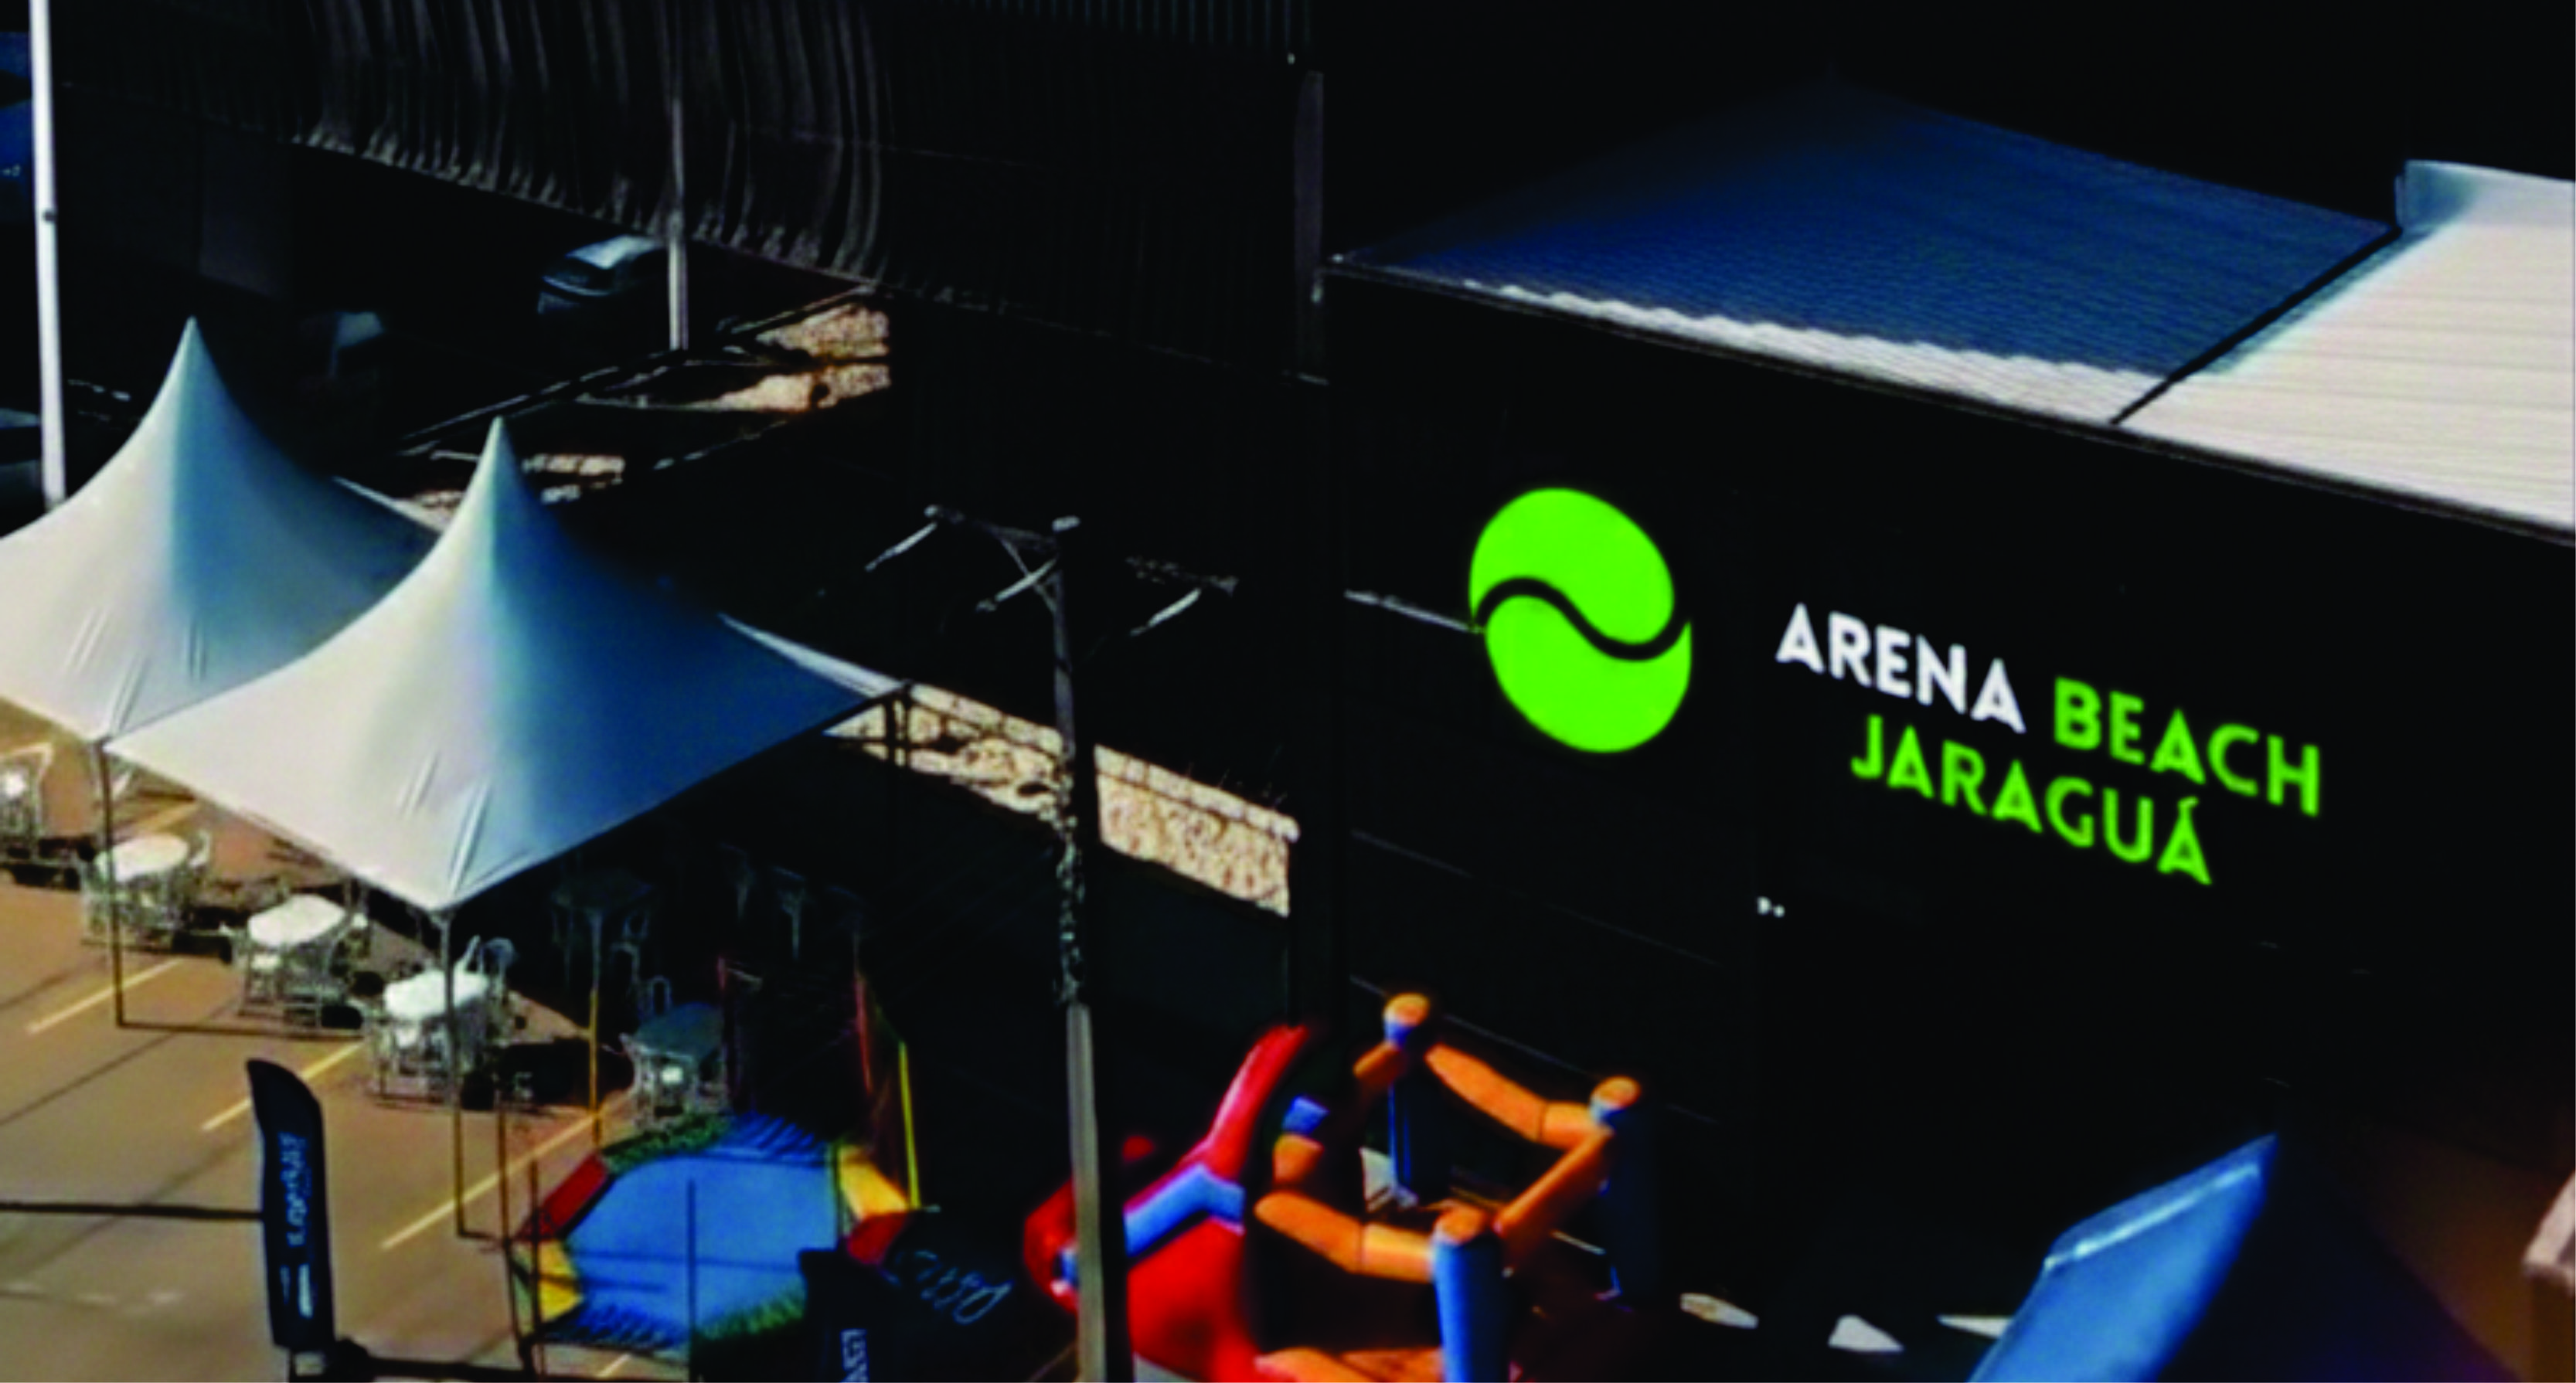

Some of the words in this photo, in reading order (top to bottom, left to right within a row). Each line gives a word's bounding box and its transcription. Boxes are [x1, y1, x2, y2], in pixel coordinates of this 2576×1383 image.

[1775, 603, 2026, 734] ARENA
[2054, 677, 2320, 817] BEACH
[1850, 714, 2211, 885] JARAGUÁ
